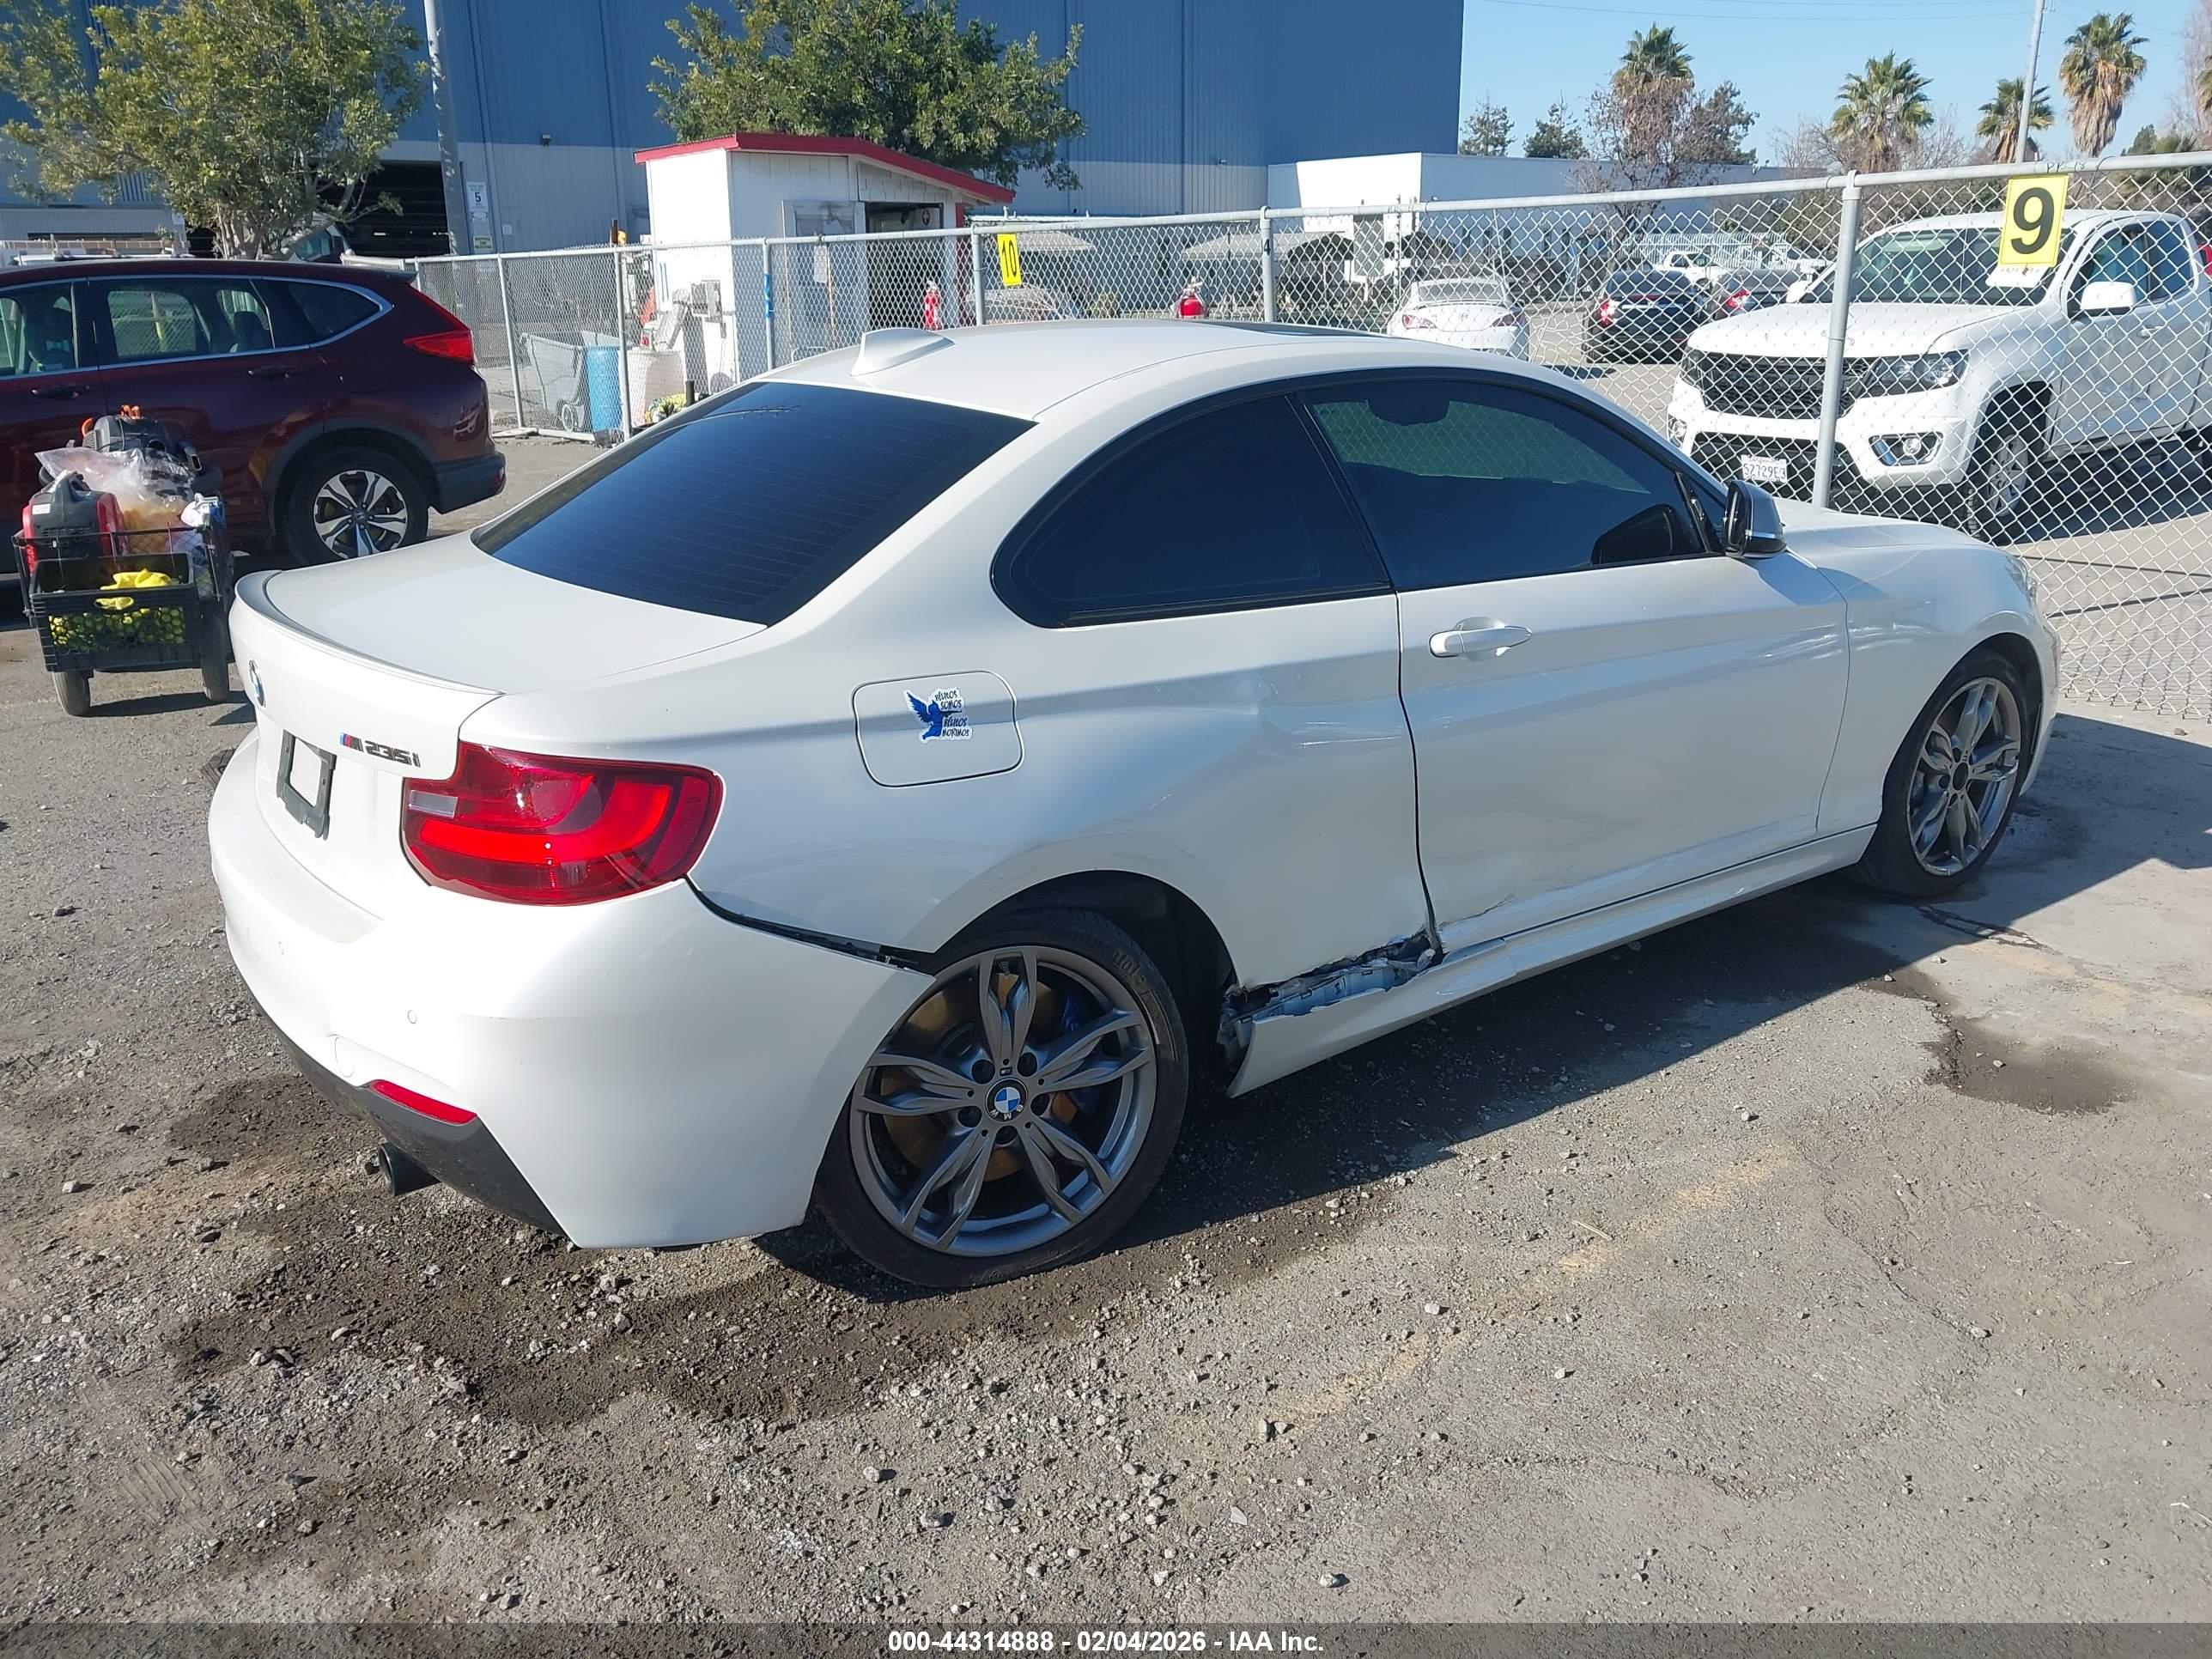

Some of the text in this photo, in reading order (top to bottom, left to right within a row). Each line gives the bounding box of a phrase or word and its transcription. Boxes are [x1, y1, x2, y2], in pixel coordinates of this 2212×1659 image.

[474, 191, 482, 203] 5
[2010, 186, 2055, 255] 9
[1263, 238, 1271, 256] 4
[1001, 240, 1017, 277] 10
[989, 1104, 1024, 1120] BMW
